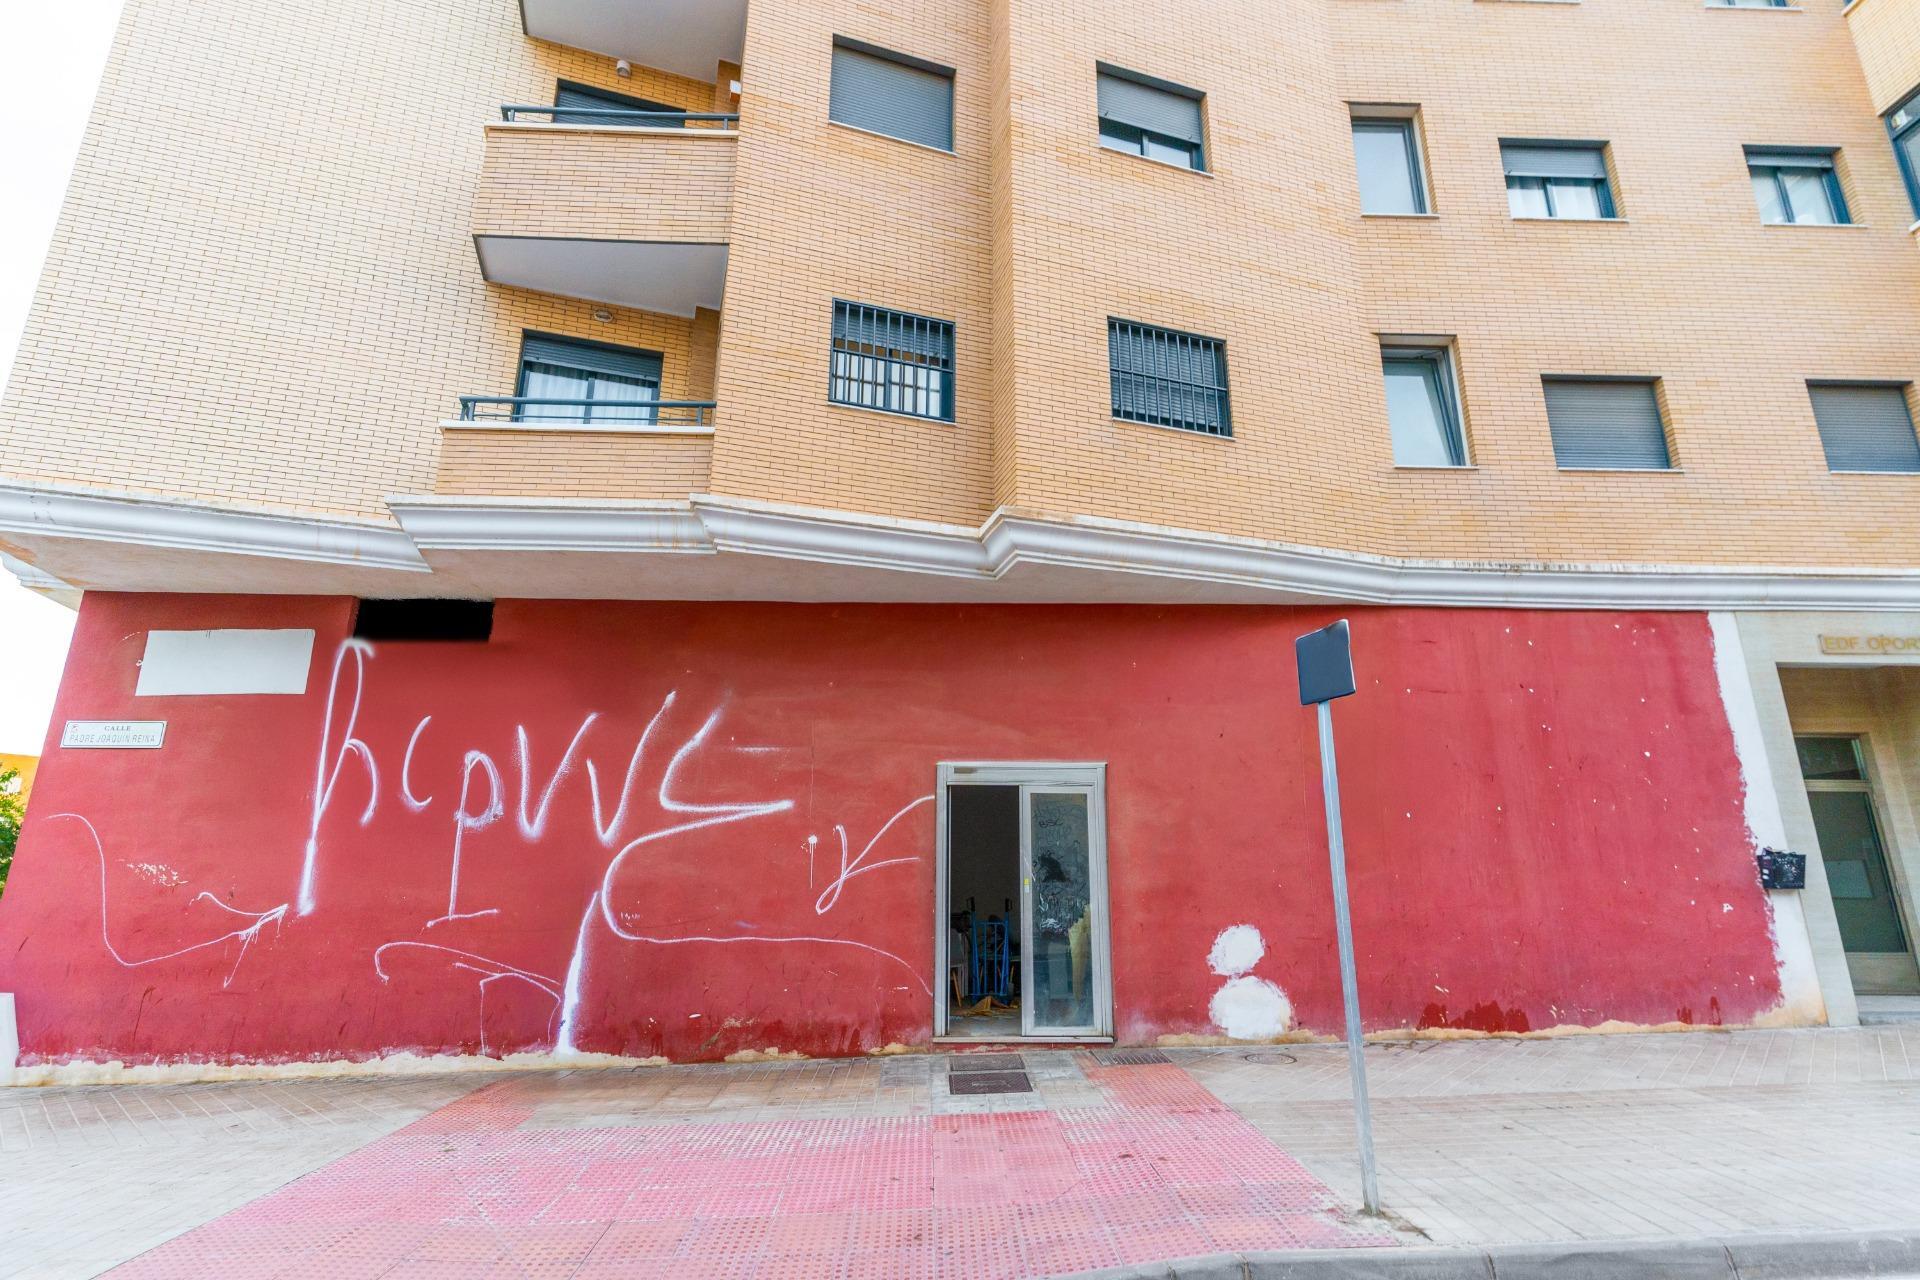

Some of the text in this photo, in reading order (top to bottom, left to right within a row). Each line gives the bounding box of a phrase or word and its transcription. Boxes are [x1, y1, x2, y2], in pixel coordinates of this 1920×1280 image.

[1867, 636, 1920, 650] OPOR
[70, 734, 155, 743] PADRE JOAQUIN REINA
